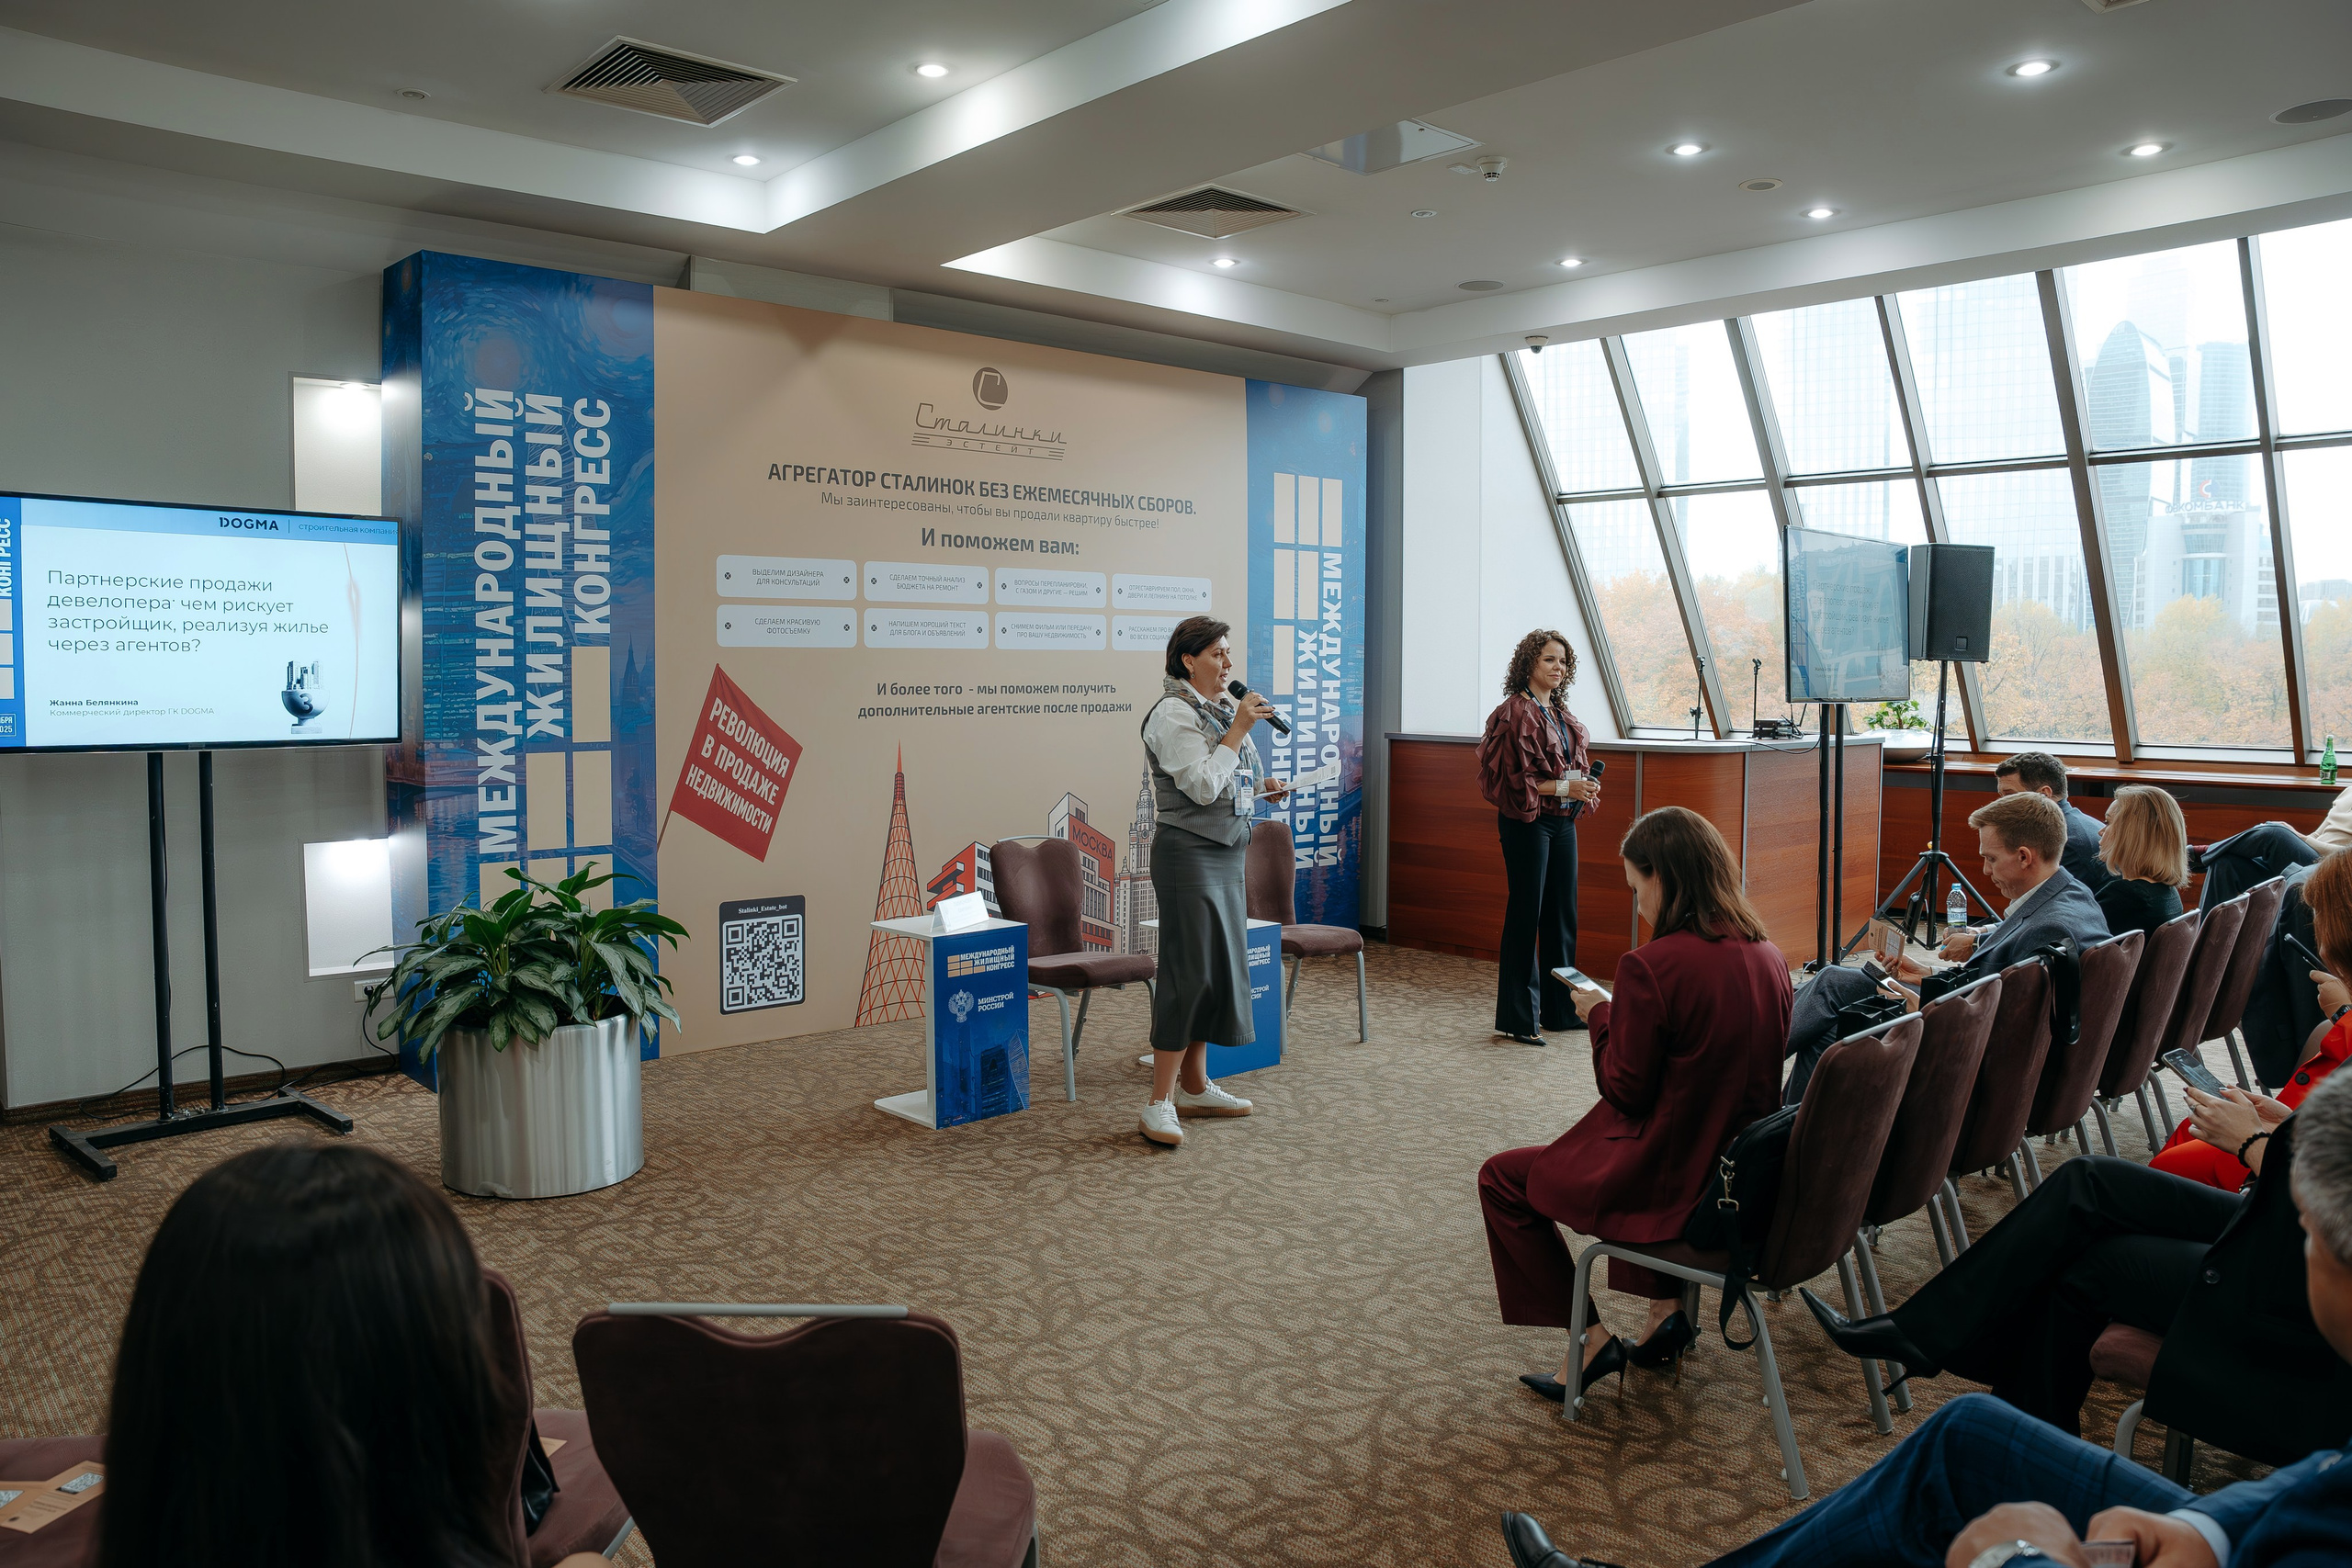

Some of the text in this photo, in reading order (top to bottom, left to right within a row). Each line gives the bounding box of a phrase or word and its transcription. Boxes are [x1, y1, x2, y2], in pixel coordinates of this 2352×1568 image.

[915, 402, 1067, 445] Сталинки
[945, 439, 1034, 455] ЭСТЕЙТ
[768, 463, 1197, 515] АГРЕГАТОР СТАЛИНОК БЕЗ ЕЖЕМЕСЯЧНЫХ СБОРОВ.
[574, 398, 612, 635] КОНГРЕСС
[820, 491, 1159, 530] Мы заинтересованы, чтобы вы продали квартиру быстрее!
[219, 516, 279, 531] DOGMA
[299, 523, 358, 533] строительная
[921, 528, 1080, 556] И поможем вам:
[514, 393, 571, 739] ЖИЛИЩНЫЙ
[752, 568, 825, 578] ВЫДЕЛИМ ДИЗАЙНЕРА
[48, 570, 273, 593] Партнерские продажи
[771, 579, 820, 587] КОНСУЛЬТАЦИЙ
[888, 573, 918, 581] СДЕЛАЕМ
[918, 574, 943, 582] ТОЧНЫЙ
[1013, 579, 1040, 587] ВОПРОСЫ
[896, 582, 926, 591] БЮДЖЕТА
[1020, 587, 1037, 595] ГАЗОМ
[180, 600, 217, 611] чем
[223, 601, 294, 615] рискует
[47, 615, 329, 636] застройщик, реализуя жилье
[464, 388, 522, 855] МЕЖДУНАРОДНЫЙ
[754, 617, 821, 626] СДЕЛАЕМ КРАСИВУЮ
[920, 620, 949, 628] ХОРОШИЙ
[766, 626, 811, 635] ФОТОСЪЕМКУ
[927, 629, 966, 637] ОБЪЯВЛЕНИЙ
[48, 639, 202, 654] через агентов?
[876, 682, 887, 695] И
[890, 682, 931, 695] более
[933, 685, 963, 695] того
[977, 684, 997, 694] мы
[1000, 683, 1059, 694] поможем
[1062, 683, 1116, 696] получить
[85, 698, 139, 706] Белянкина
[50, 707, 120, 717] Коммерческий
[123, 708, 166, 717] директор
[857, 703, 1133, 719] дополнительные агентские после продажи
[708, 696, 791, 779] РЕВОЛЮЦИЯ
[700, 733, 780, 806] В ПРОДАЖЕ
[684, 763, 774, 834] НЕДВИЖИМОСТИ
[1072, 825, 1114, 863] МОСКВА
[738, 904, 787, 914] Stalinki_Estate_bot
[960, 944, 1014, 962] МЕЖДУНАРОДНЫЙ
[1248, 944, 1271, 955] АРОДНЫЙ
[974, 953, 1014, 966] ЖИЛИЩНЫЙ
[986, 961, 1015, 972] КОНГРЕСС
[1250, 984, 1270, 994] СТРОЙ
[1250, 992, 1262, 1000] СИИ
[978, 991, 1014, 1005] МИНСТРОЙ
[978, 1001, 1004, 1012] РОССИИ
